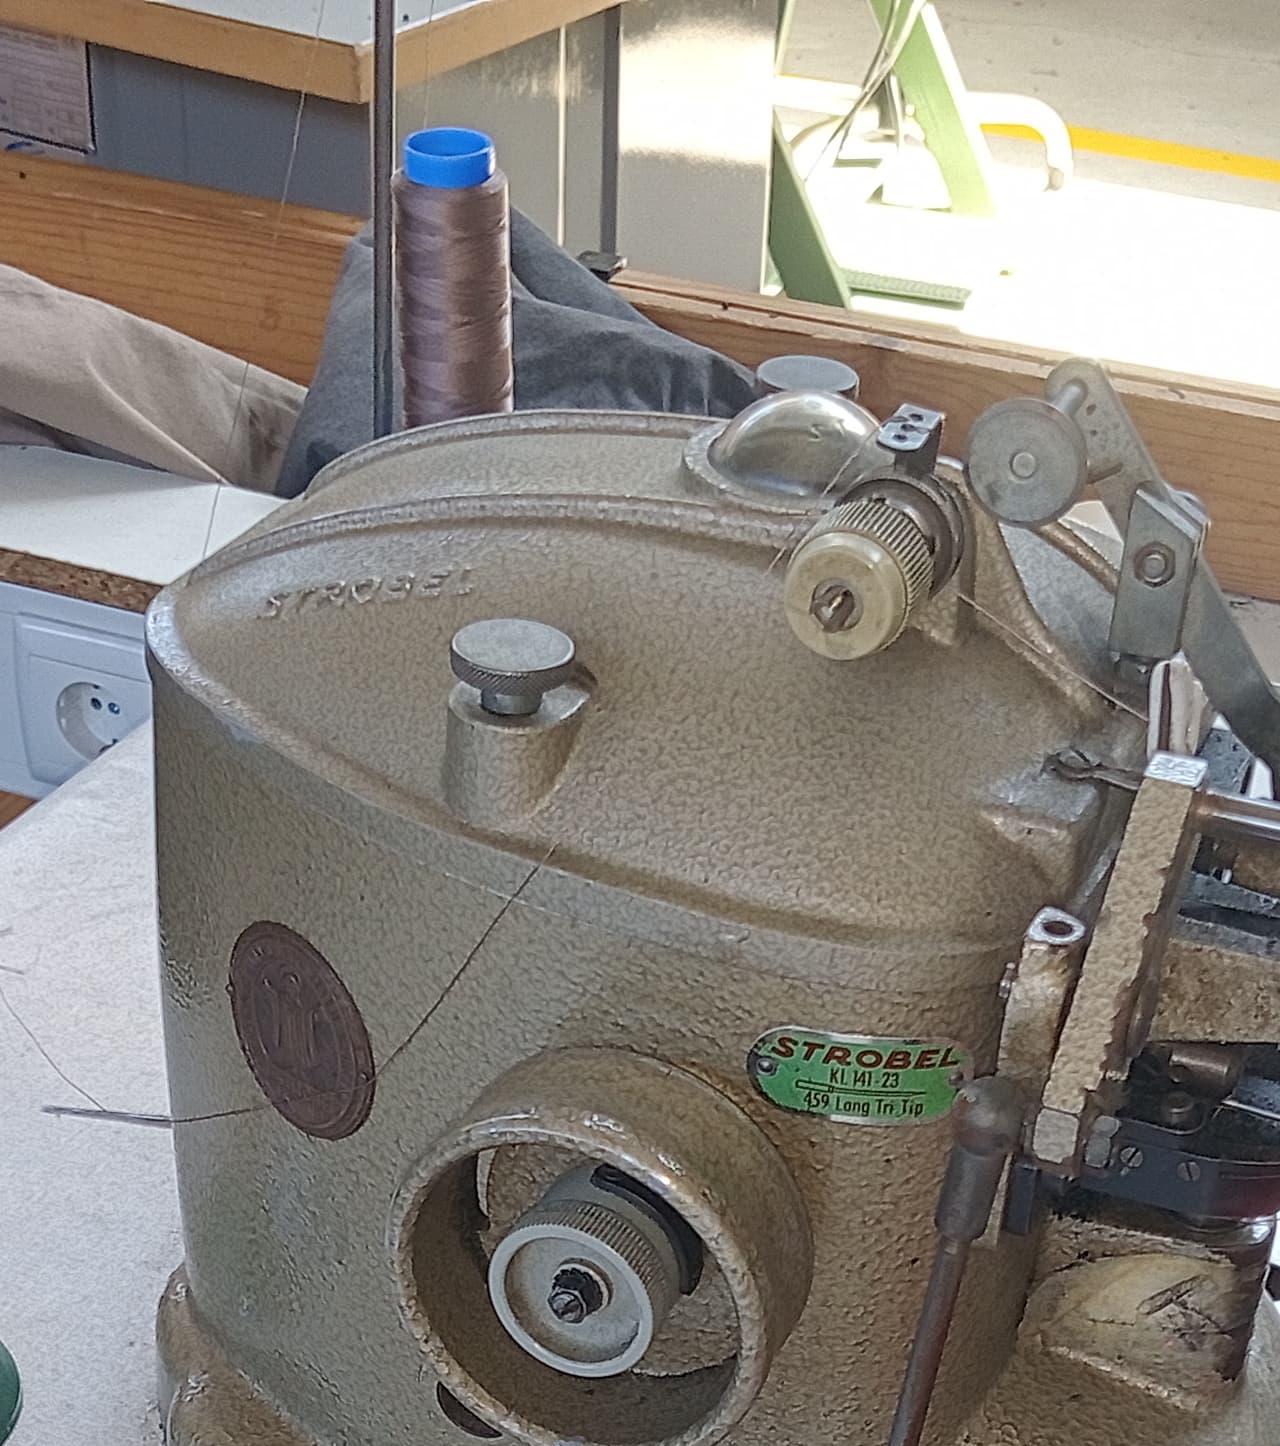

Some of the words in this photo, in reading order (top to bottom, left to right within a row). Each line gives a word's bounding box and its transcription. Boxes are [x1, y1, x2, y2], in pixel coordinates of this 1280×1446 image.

[771, 1035, 960, 1070] STROBEL
[829, 1067, 848, 1086] KL
[803, 1091, 830, 1109] 459
[896, 1099, 924, 1118] Tip
